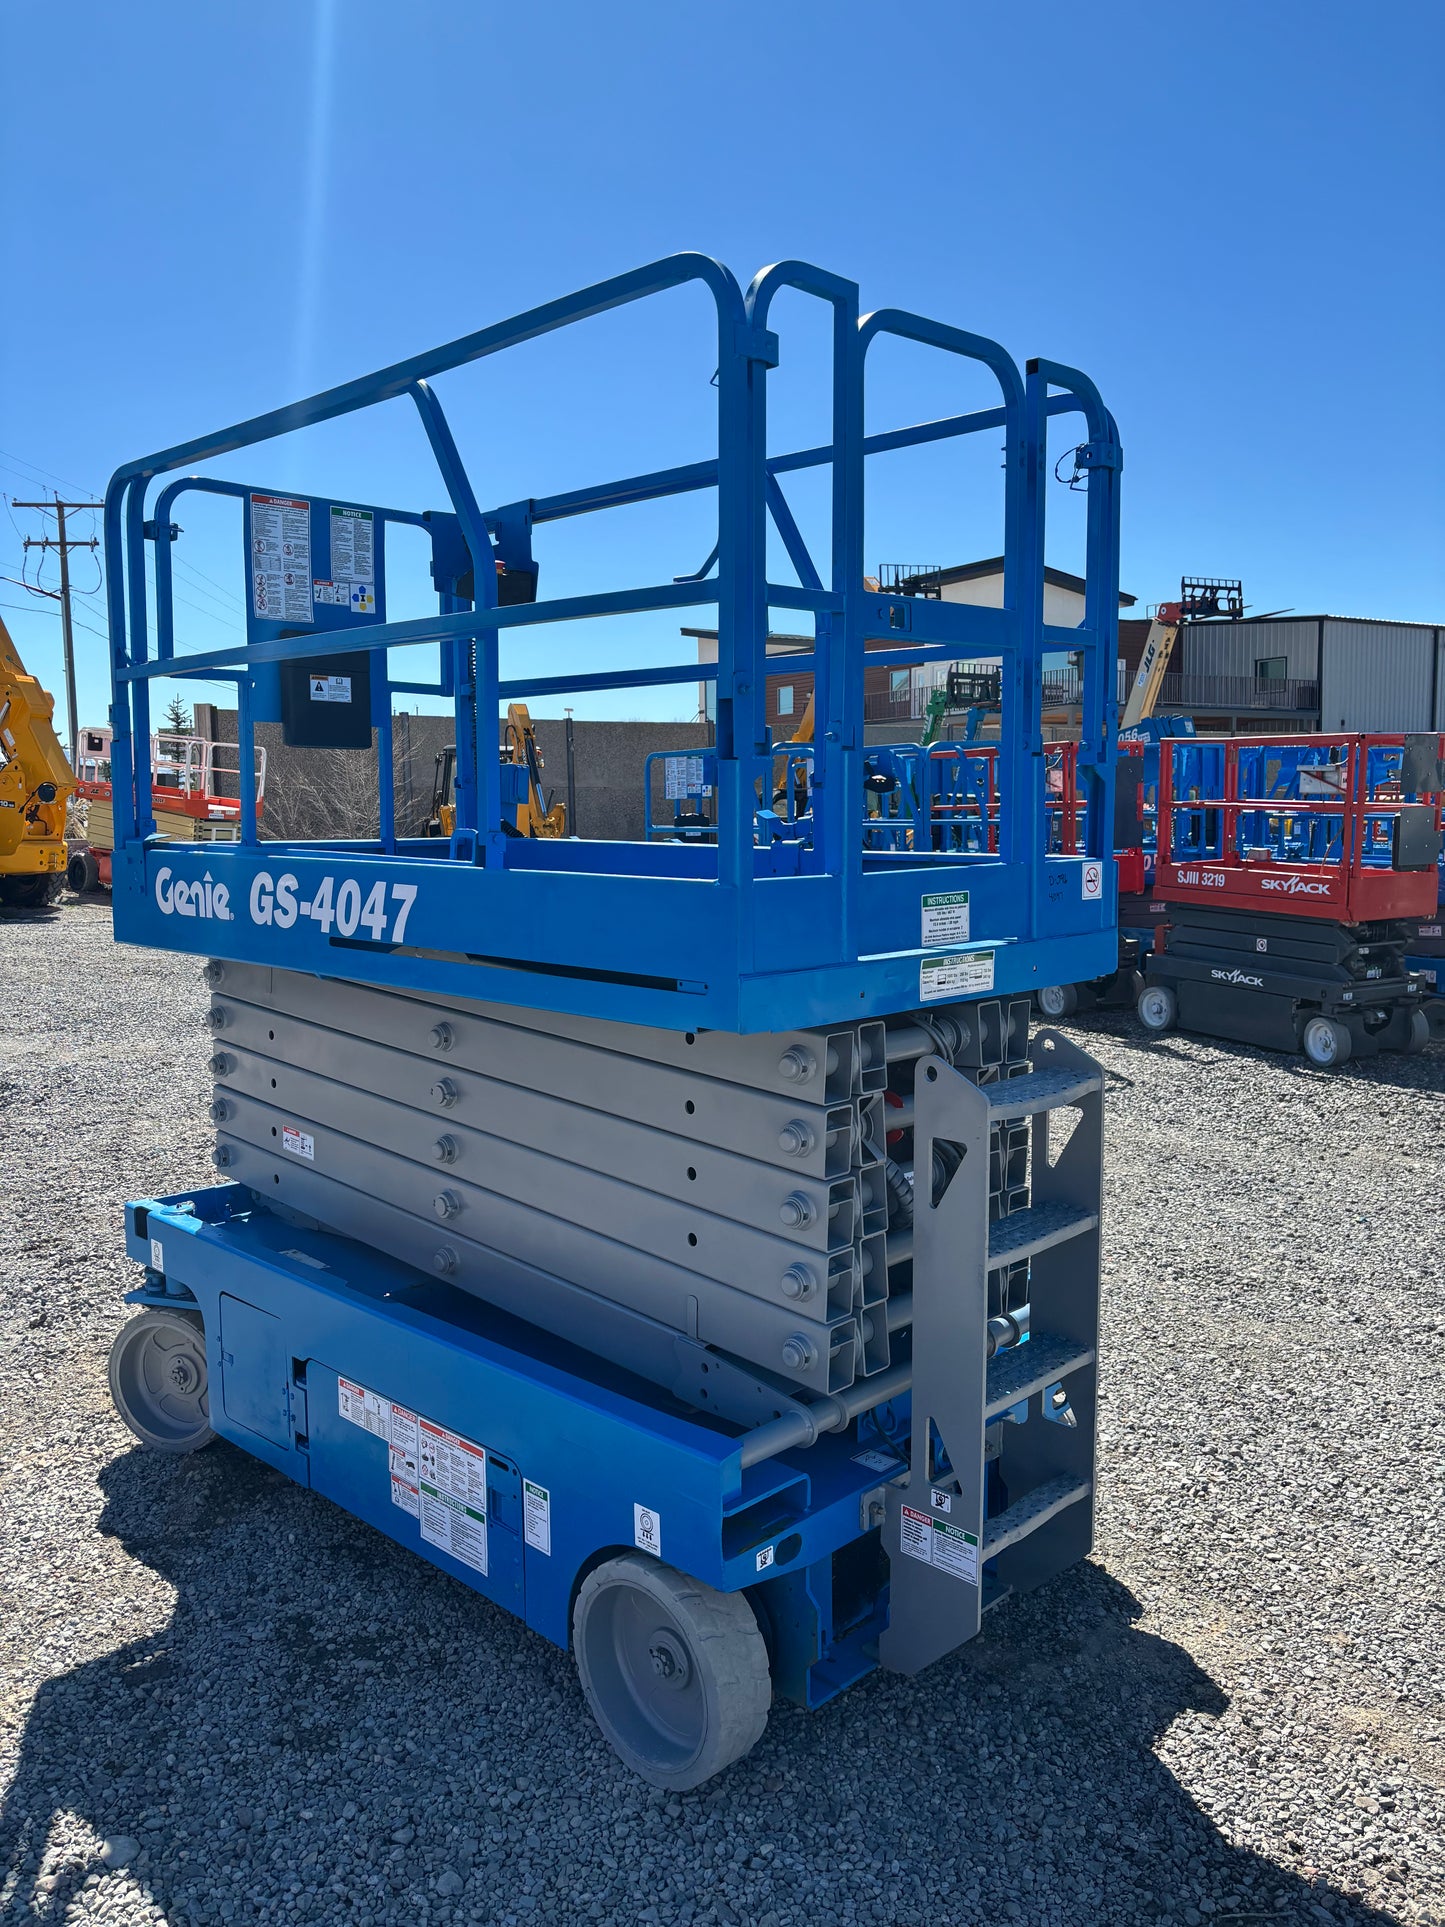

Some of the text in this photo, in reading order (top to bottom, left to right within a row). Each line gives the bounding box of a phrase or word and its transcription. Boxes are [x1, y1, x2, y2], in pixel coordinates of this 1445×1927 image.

[342, 510, 362, 518] NOTICE
[1143, 644, 1156, 673] JLG
[1177, 869, 1226, 887] SJIII 3219
[1261, 876, 1331, 895] SKYJACK
[155, 866, 418, 943] Genie GS-4047
[927, 894, 965, 906] INSTRUCTIONS
[1211, 969, 1264, 987] SKYJACK
[397, 1405, 416, 1422] DANGER
[528, 1485, 544, 1499] NOTICE
[910, 1510, 932, 1525] DANGER
[945, 1525, 966, 1540] NOTICE
